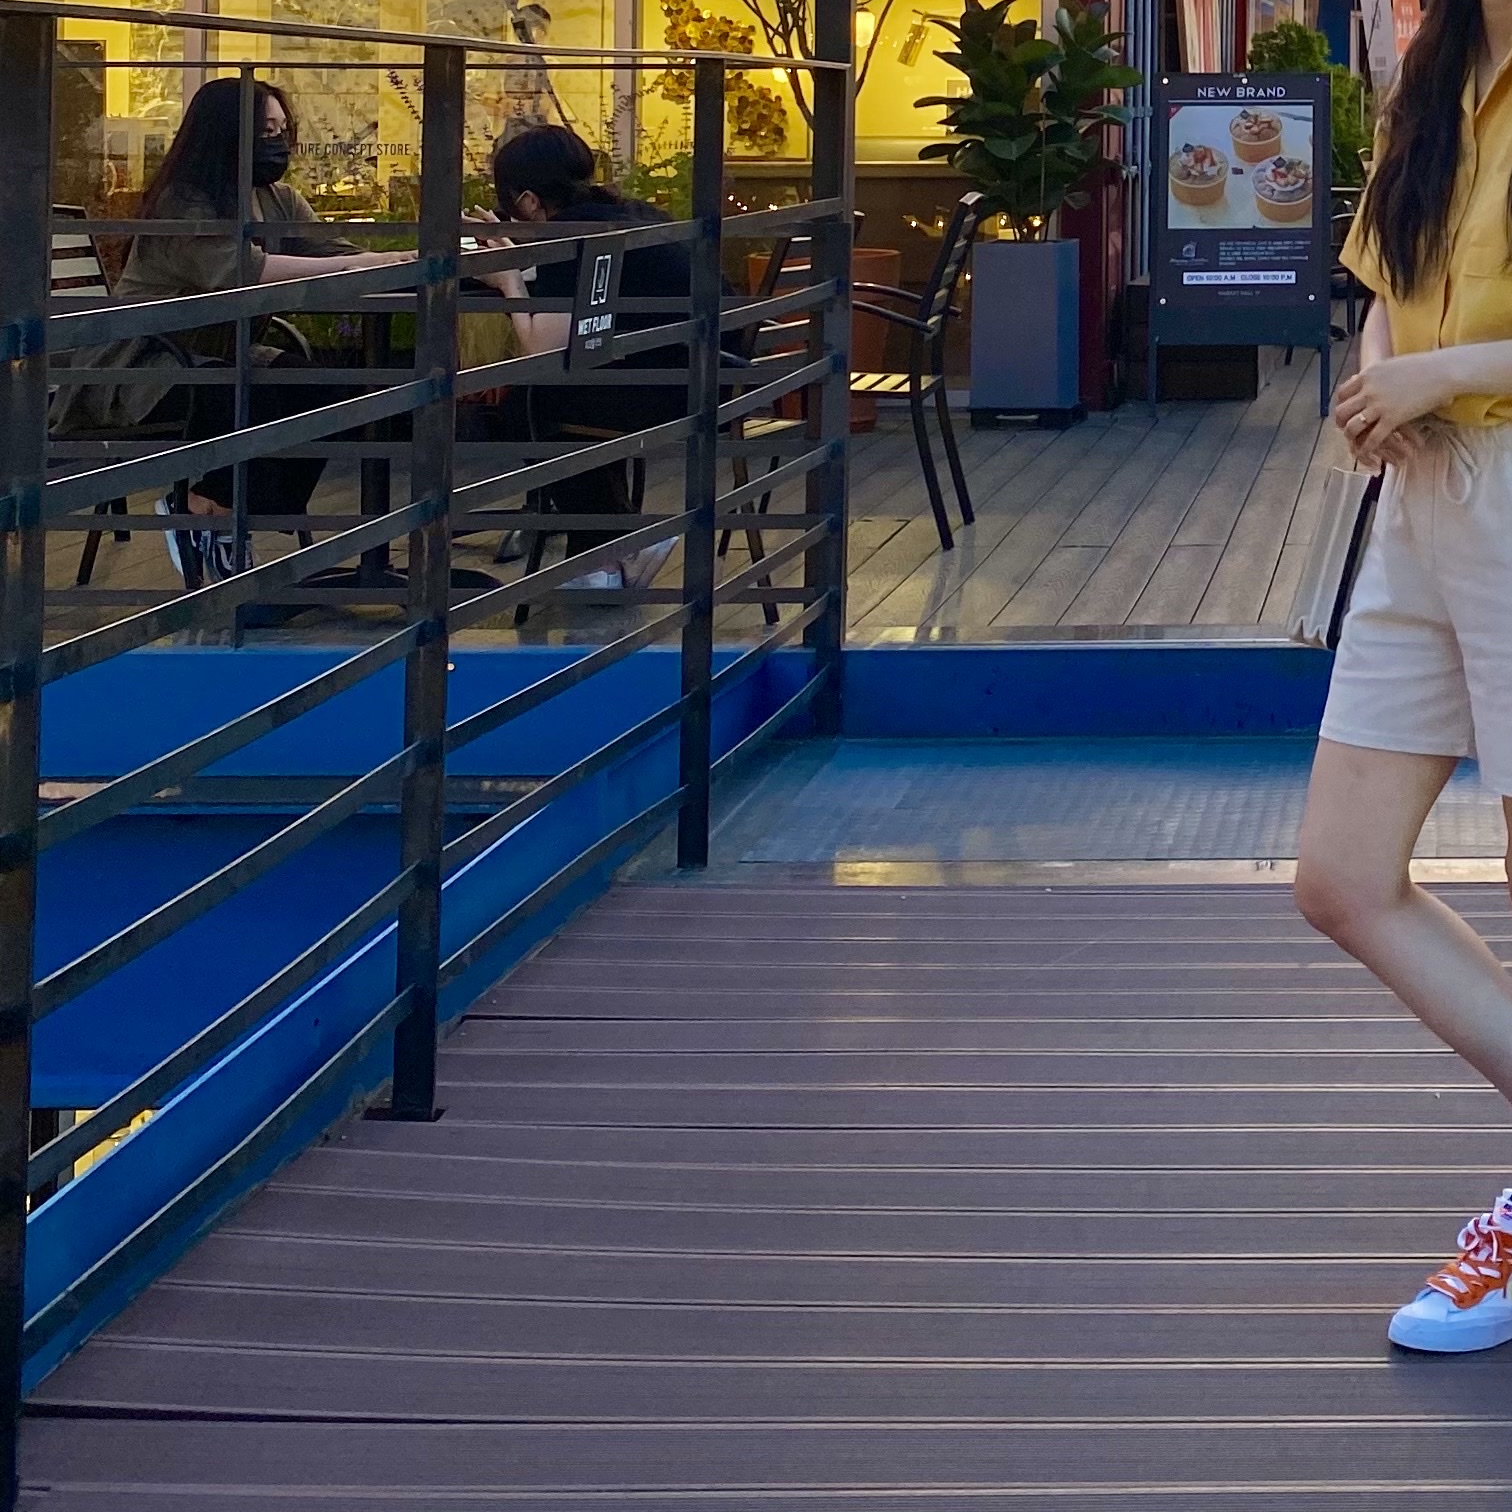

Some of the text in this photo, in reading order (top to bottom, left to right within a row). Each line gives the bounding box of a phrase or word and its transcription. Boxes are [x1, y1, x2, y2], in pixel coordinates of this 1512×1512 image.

[1197, 86, 1286, 98] NEW BRAND
[377, 143, 410, 156] STORE
